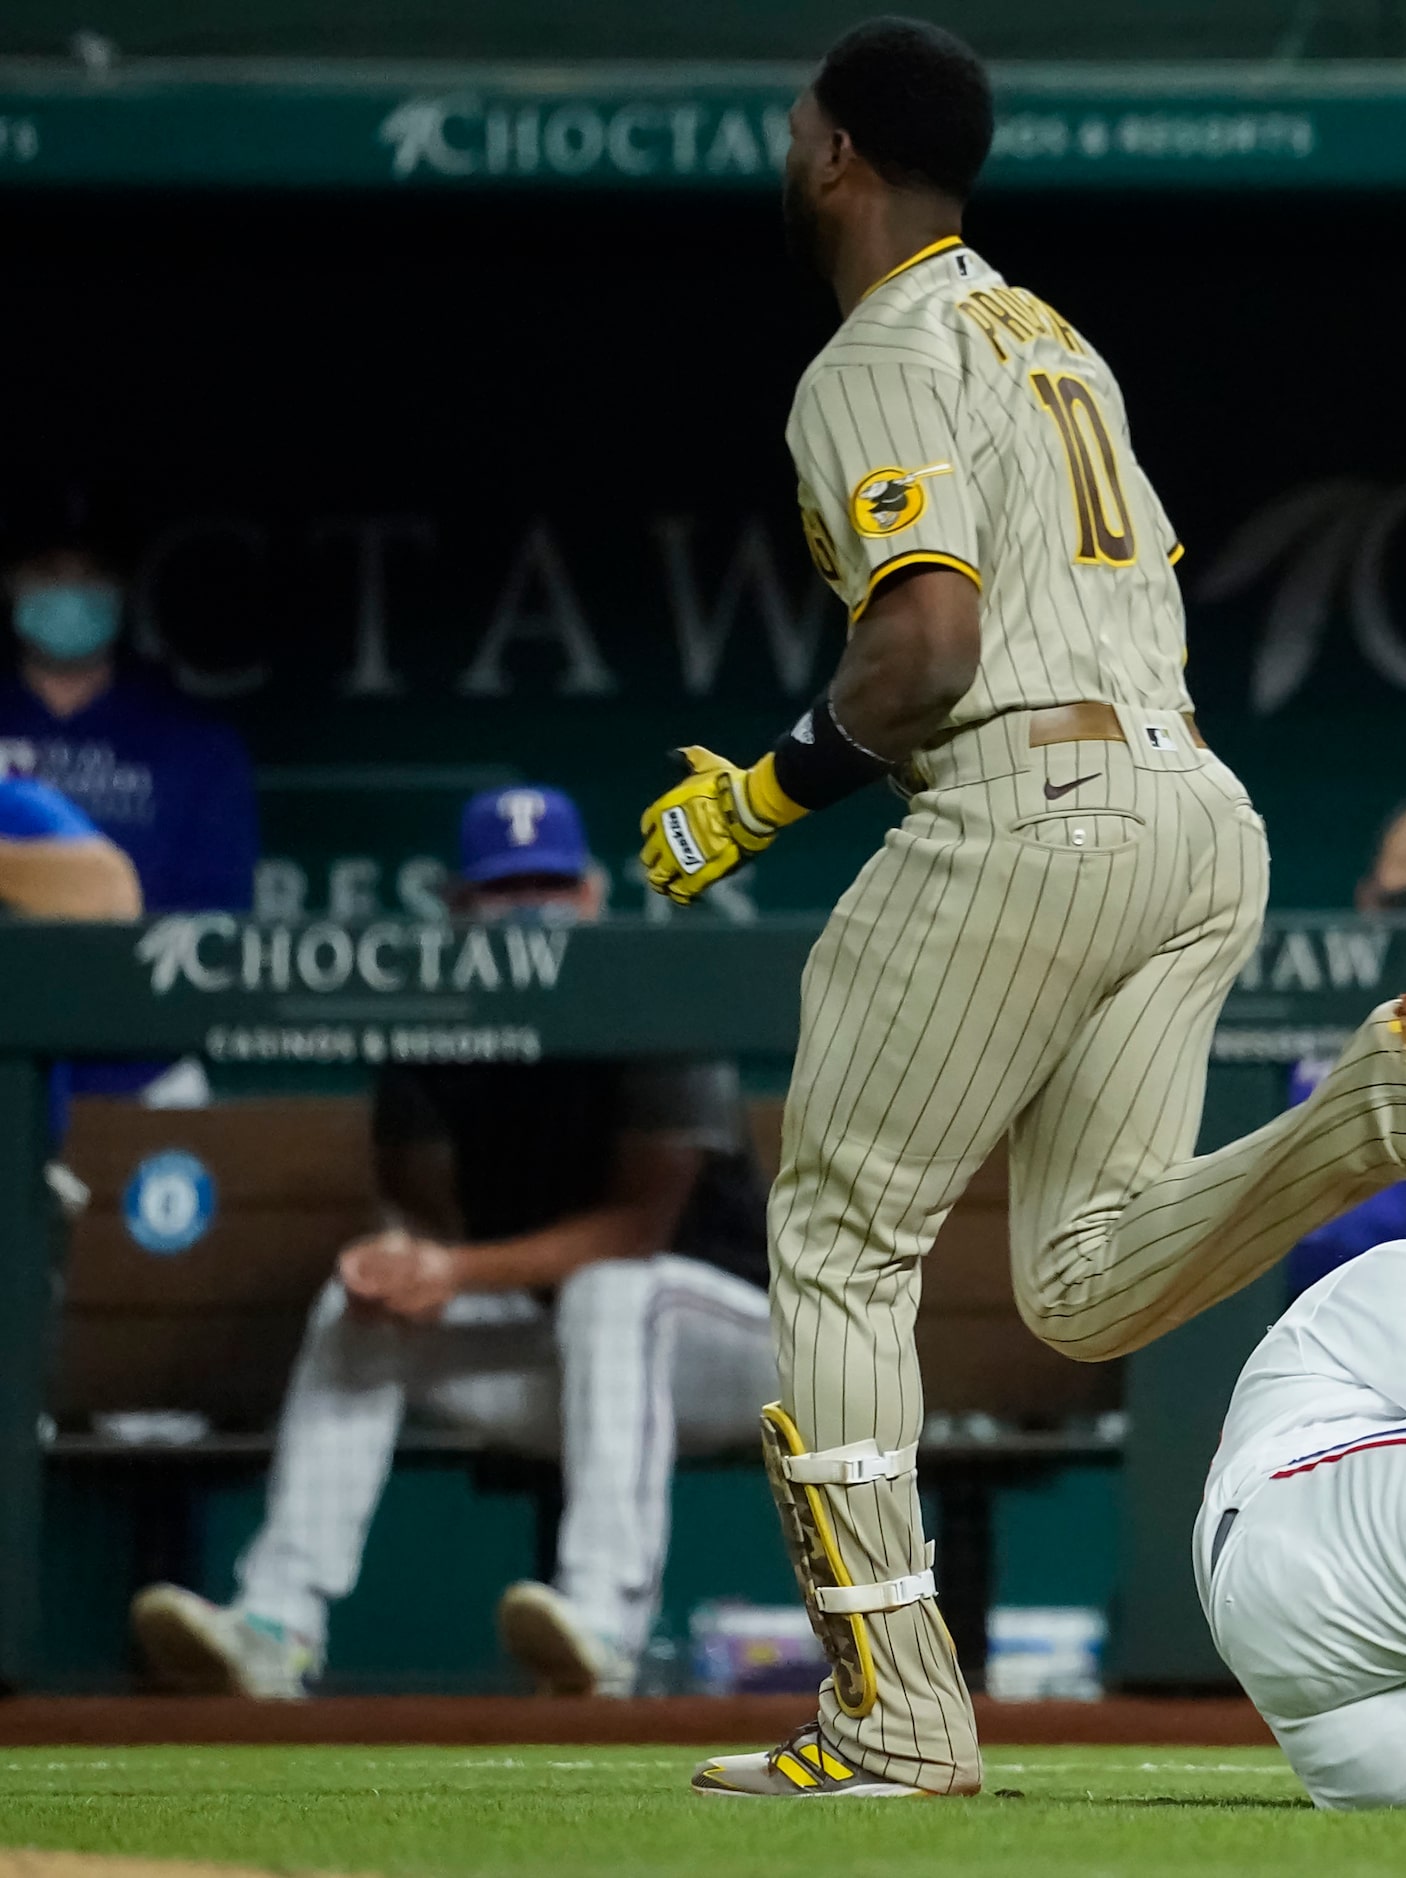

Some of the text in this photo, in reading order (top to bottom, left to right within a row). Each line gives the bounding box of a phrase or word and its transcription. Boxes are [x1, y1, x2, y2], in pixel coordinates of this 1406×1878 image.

[427, 95, 792, 176] CHOCTA
[1029, 369, 1138, 568] 10
[187, 912, 570, 992] CHOCTAW
